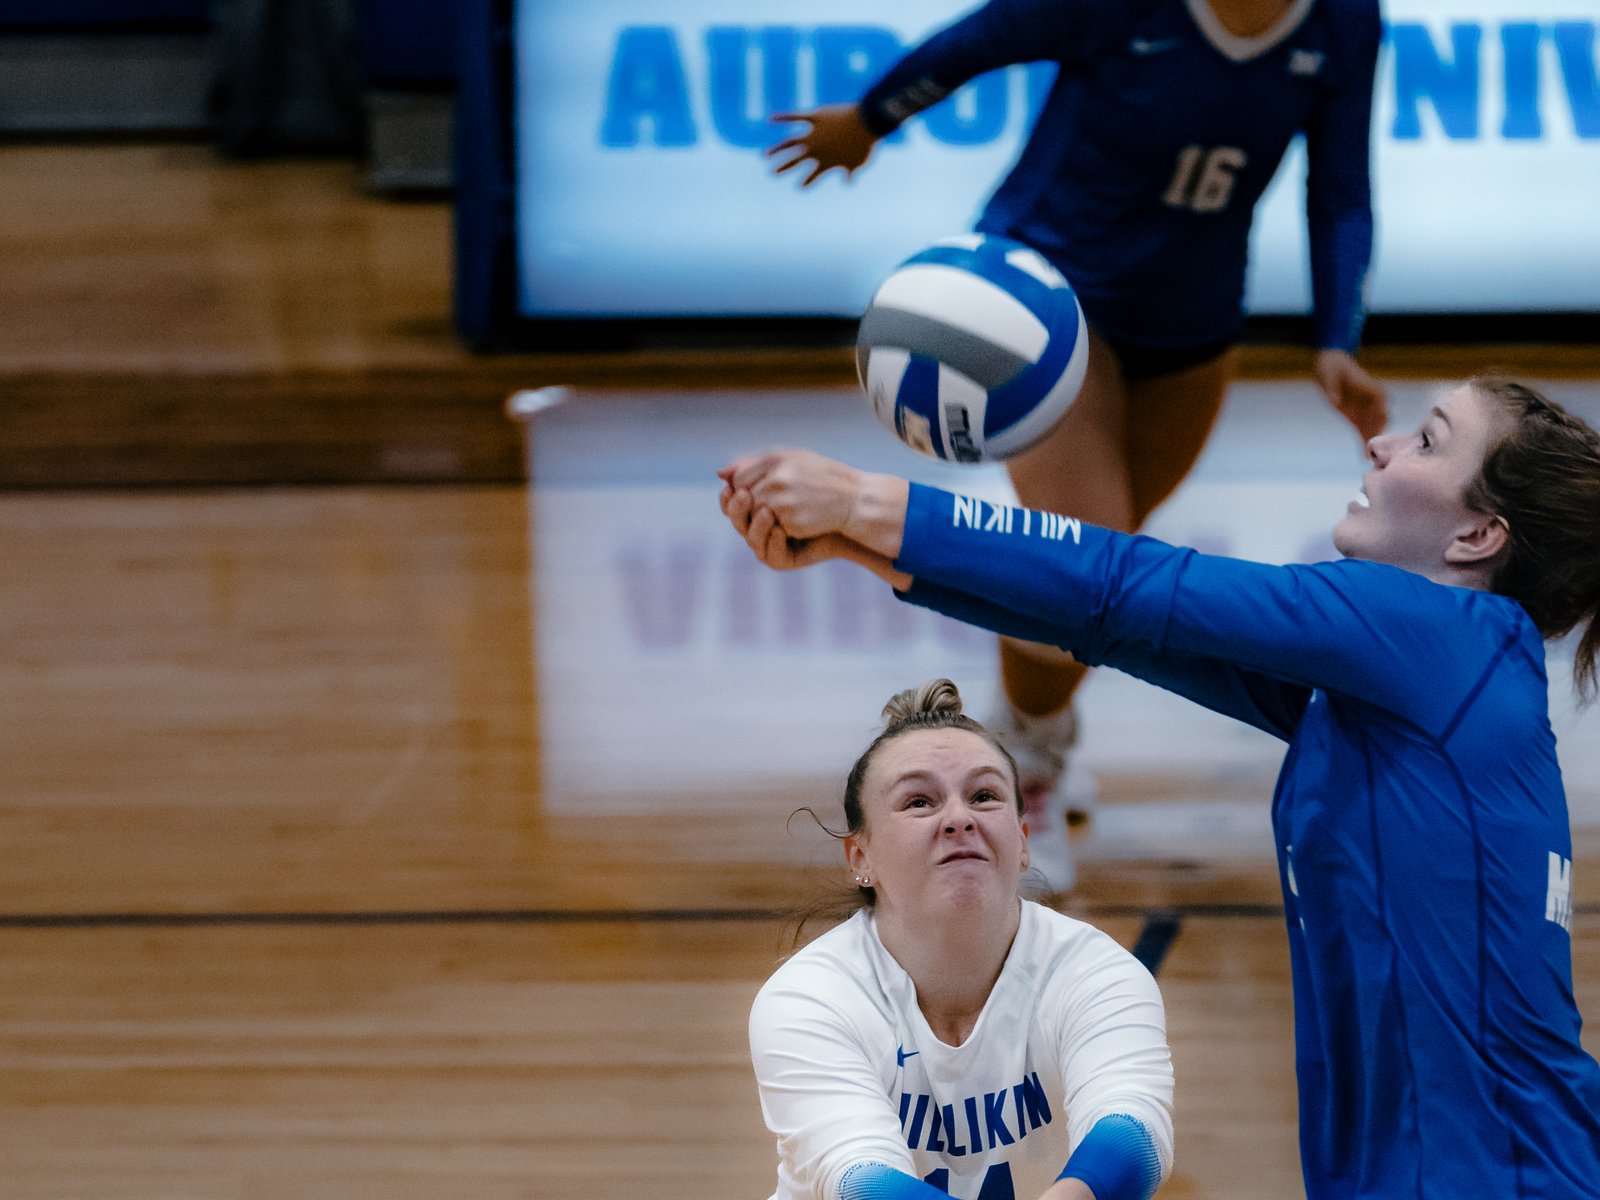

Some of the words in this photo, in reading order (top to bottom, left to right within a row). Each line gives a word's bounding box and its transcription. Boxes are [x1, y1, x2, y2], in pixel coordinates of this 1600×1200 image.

[1382, 22, 1600, 139] NIV
[1163, 146, 1247, 210] 16
[953, 493, 1081, 545] MILLIKIN
[899, 1072, 1053, 1157] ILLIKIN
